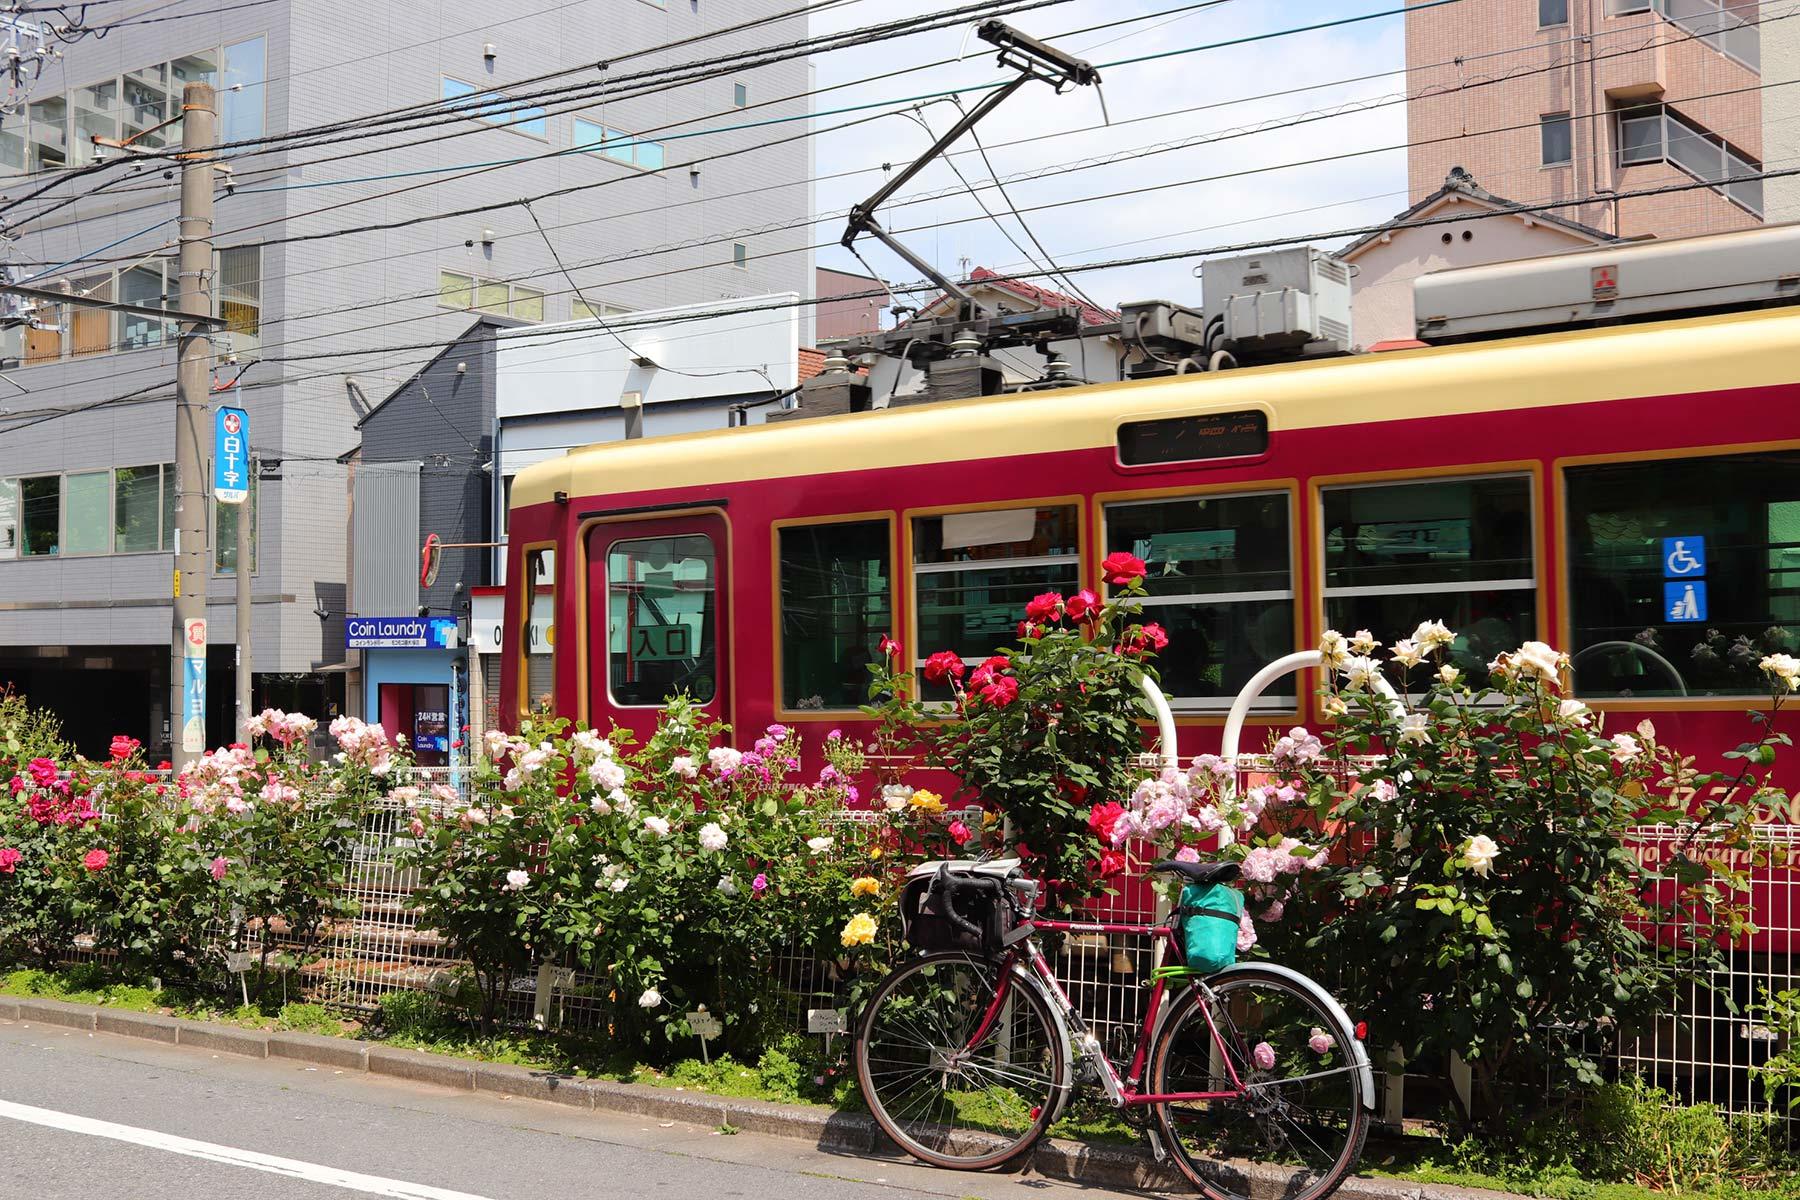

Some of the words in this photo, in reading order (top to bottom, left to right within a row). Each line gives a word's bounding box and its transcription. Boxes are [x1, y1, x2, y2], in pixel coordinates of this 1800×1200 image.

[223, 436, 240, 487] 白十字
[349, 621, 376, 636] Coin
[378, 620, 427, 639] Laundry
[635, 629, 686, 657] 入口
[1069, 923, 1105, 931] Panasonic
